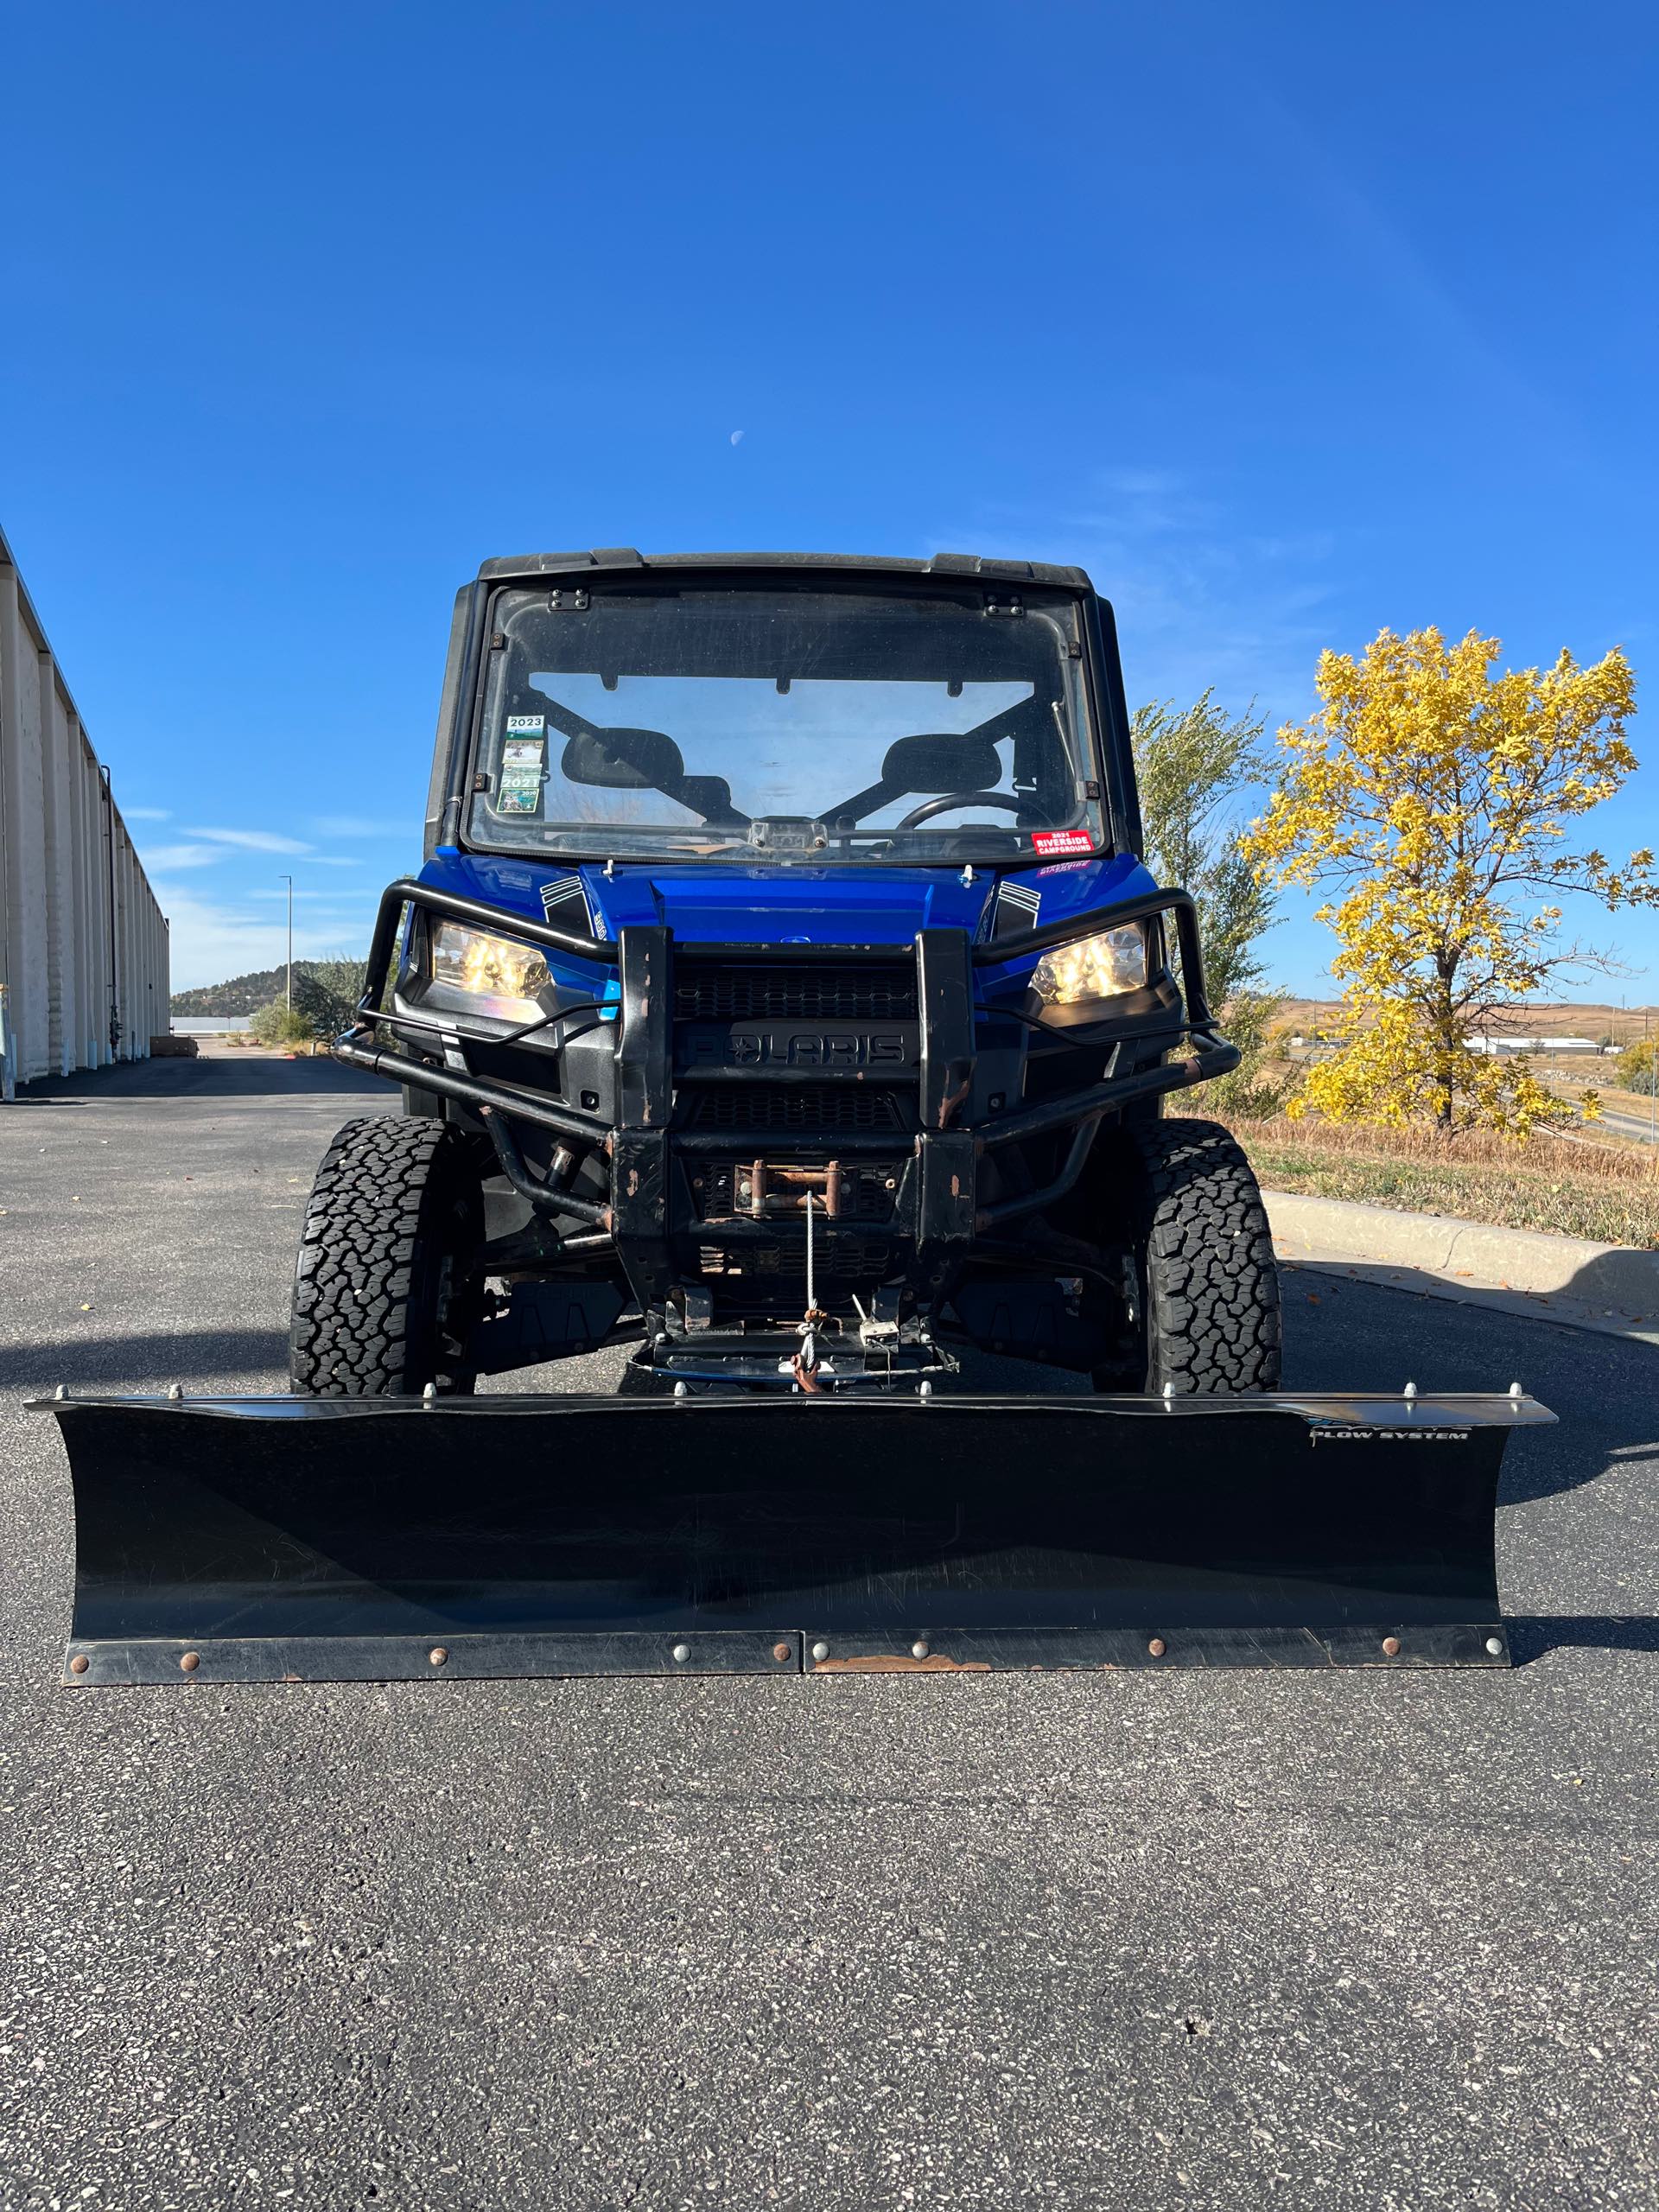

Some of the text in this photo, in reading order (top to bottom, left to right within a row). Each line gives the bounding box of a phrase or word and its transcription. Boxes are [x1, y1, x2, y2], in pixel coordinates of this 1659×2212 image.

[511, 718, 542, 727] 2023
[1037, 836, 1089, 848] RIVERSIDE
[1039, 844, 1091, 854] CAMPGROUND
[686, 1033, 905, 1065] POLARIS
[1309, 1431, 1469, 1440] PLOW SYSTEM
